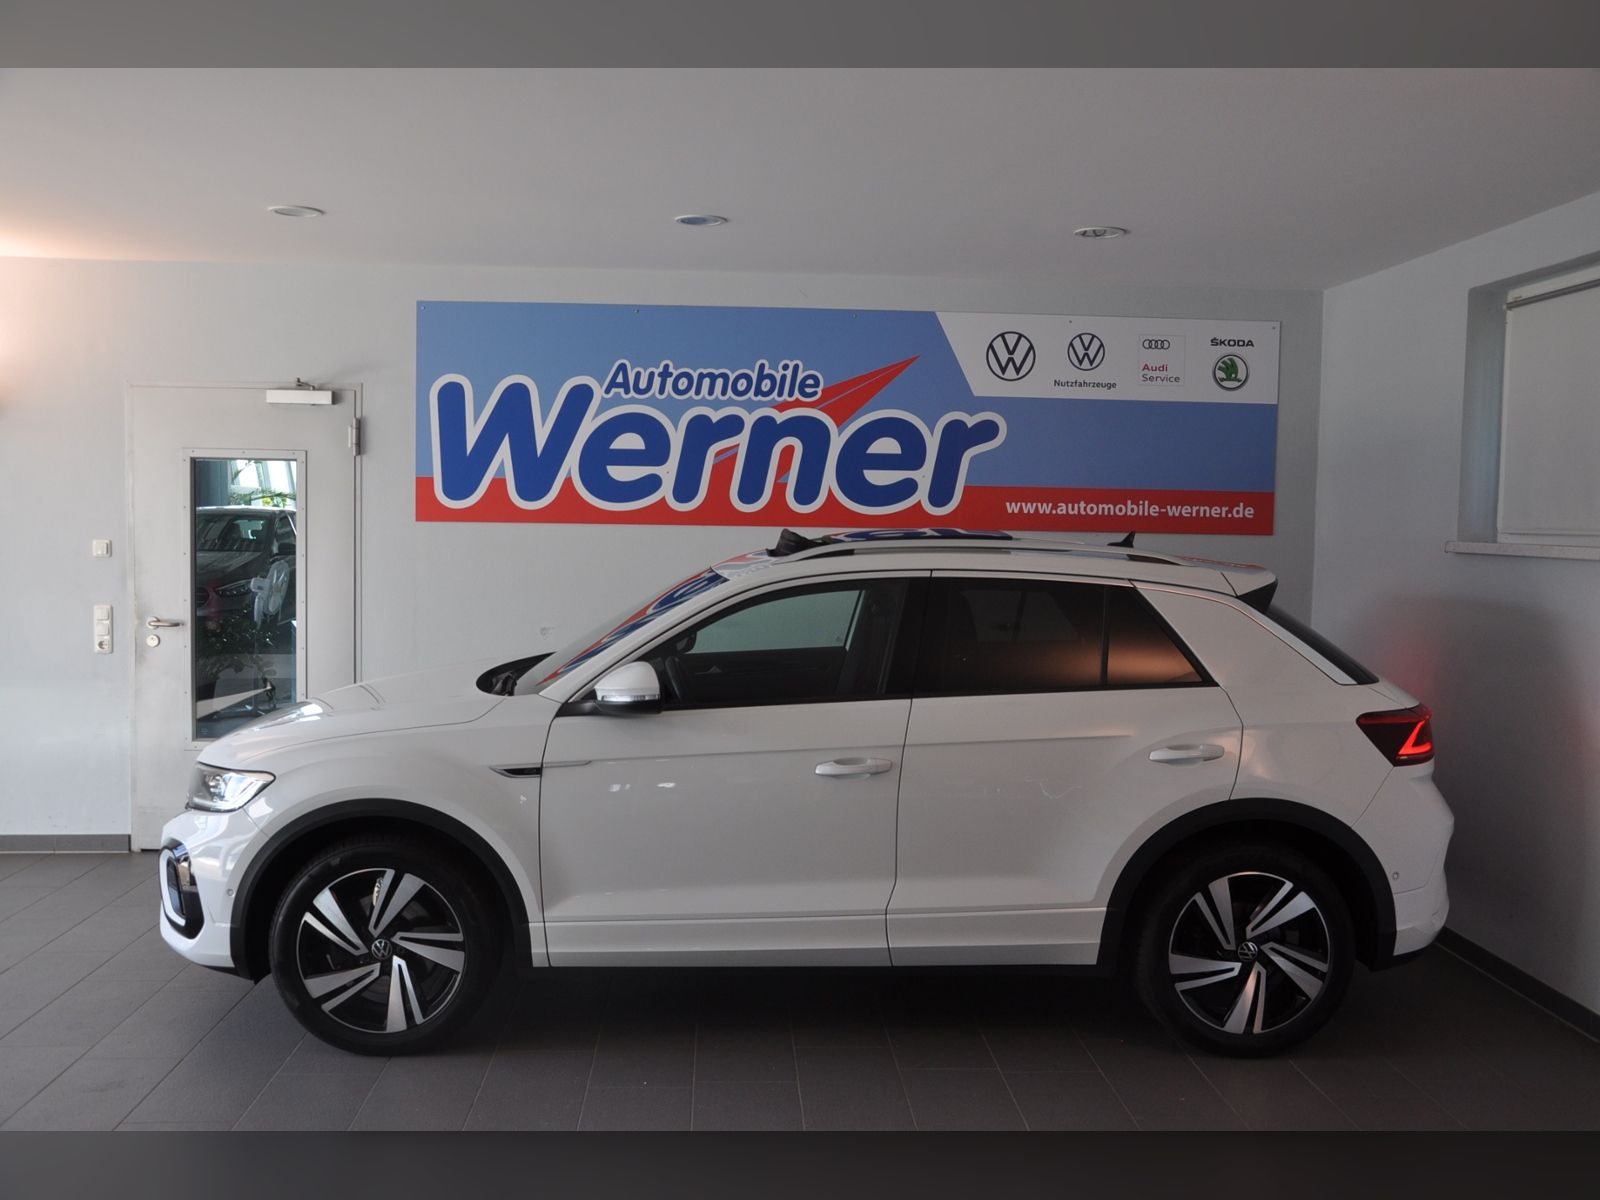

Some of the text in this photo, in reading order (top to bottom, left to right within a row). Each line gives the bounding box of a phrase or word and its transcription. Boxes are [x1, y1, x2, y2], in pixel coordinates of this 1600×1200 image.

[1210, 337, 1255, 348] ŠKODA
[1142, 364, 1168, 373] Audi
[605, 361, 821, 399] Automobile
[1142, 373, 1180, 384] Service
[1053, 379, 1117, 391] Nutzfahrzeuge
[433, 377, 1003, 511] Werner
[1005, 500, 1255, 519] www.automobile-werner.de
